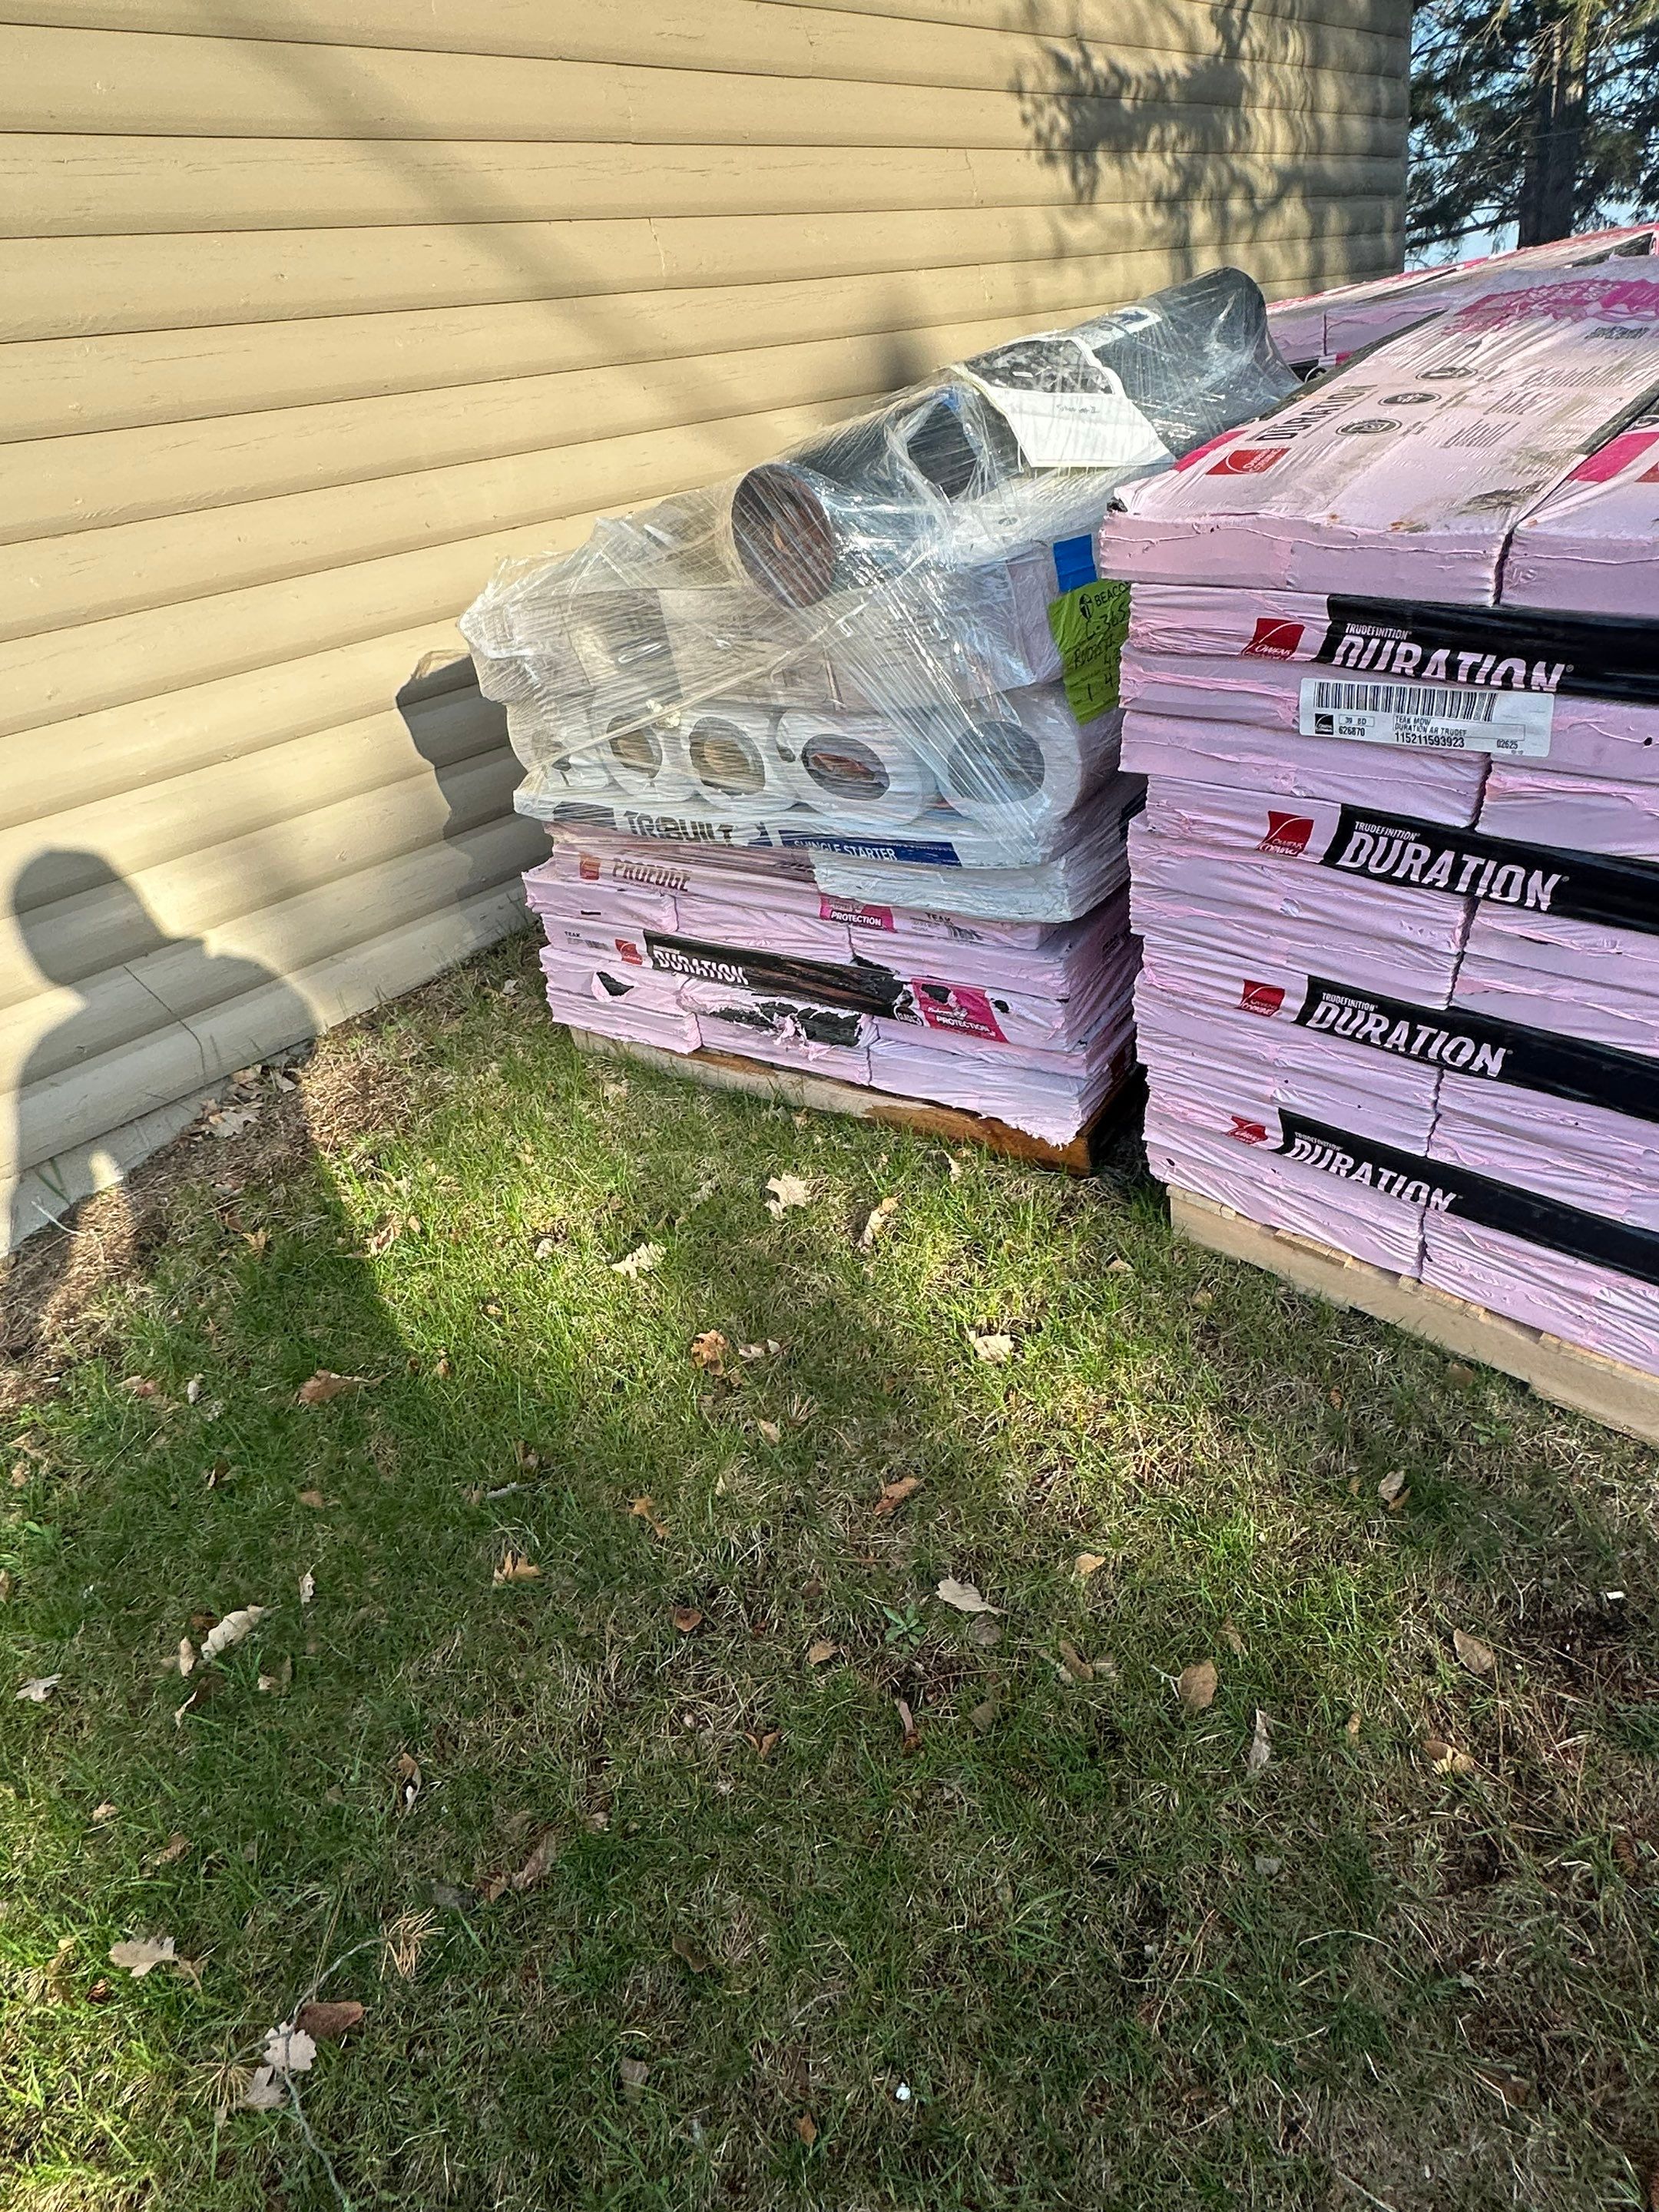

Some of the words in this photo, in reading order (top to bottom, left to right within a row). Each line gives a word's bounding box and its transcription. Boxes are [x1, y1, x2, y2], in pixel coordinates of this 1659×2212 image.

[1094, 582, 1128, 606] BEACO
[1345, 623, 1408, 640] TRUDEFINITION
[1331, 634, 1565, 691] DURATION
[1395, 724, 1426, 733] DURATION
[1395, 733, 1465, 748] 115211593923
[1355, 821, 1418, 841] TRUDEFINITION
[843, 845, 898, 861] STARTER
[1337, 831, 1561, 912] DURATION
[830, 911, 882, 926] PROTECTION
[653, 951, 749, 986] DURATION
[1323, 992, 1376, 1012] TRUDEFINITION
[935, 1015, 991, 1032] PROTECTION
[1306, 1001, 1507, 1077] DURATION
[1283, 1137, 1458, 1211] DURATION
